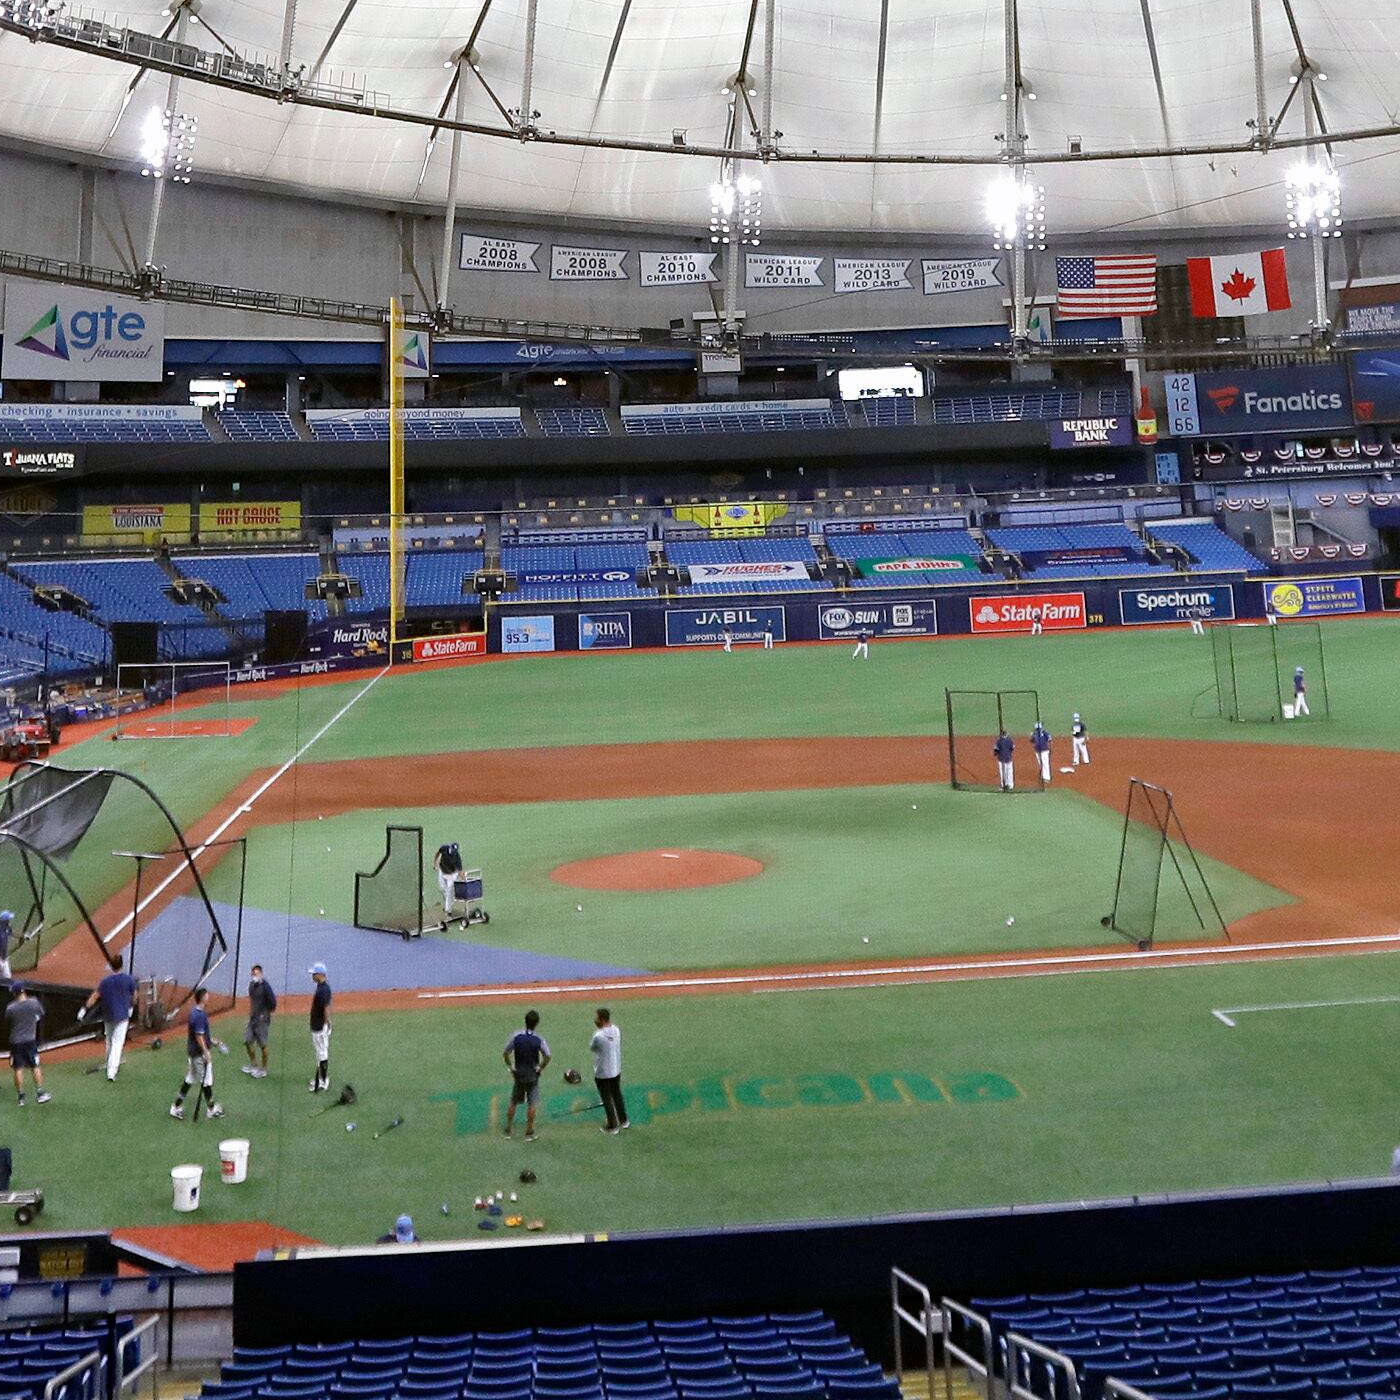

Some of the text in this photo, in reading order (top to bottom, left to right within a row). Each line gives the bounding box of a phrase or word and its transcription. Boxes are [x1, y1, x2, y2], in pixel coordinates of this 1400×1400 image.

[482, 239, 517, 249] AL EAST
[478, 247, 519, 261] 2008
[557, 250, 591, 258] AMERICAN
[466, 258, 528, 270] CHAMPIONS
[568, 257, 608, 269] 2008
[657, 261, 697, 274] 2010
[926, 260, 992, 271] AMERICAN LEAGUE
[556, 268, 618, 278] CHAMPIONS
[646, 273, 707, 282] CHAMPIONS
[764, 265, 801, 277] 2011
[854, 269, 892, 280] 2013
[941, 268, 975, 281] 2019
[754, 276, 779, 284] WILD
[842, 279, 900, 288] WILD CARD
[933, 278, 987, 289] WILD CARD
[70, 304, 146, 350] gte
[83, 344, 154, 363] financial
[1171, 377, 1190, 391] 42
[663, 401, 788, 414] auto credit cards home
[1175, 397, 1189, 412] 12
[1243, 389, 1343, 415] Fanatics
[1, 405, 178, 419] checking insurance savings
[432, 408, 466, 419] money
[1062, 418, 1119, 432] REPUBLIC
[1175, 417, 1194, 432] 66
[1074, 429, 1109, 442] BANK
[1271, 464, 1325, 475] Petersburg
[1326, 462, 1372, 471] Welcomes
[217, 507, 240, 526] HOT
[721, 563, 782, 575] HUGHES
[877, 561, 912, 572] PAPA
[525, 572, 600, 582] MOFFITT
[1137, 591, 1210, 612] Spectrum
[1306, 591, 1357, 602] CLEARWATER
[695, 611, 758, 625] JABIL
[854, 610, 880, 624] SUN
[332, 627, 388, 643] Hard Rock
[594, 621, 625, 636] RIPA
[505, 633, 529, 644] 95.3
[686, 633, 716, 643] SUPPORTS
[300, 660, 328, 673] Hard Rock
[236, 669, 266, 682] Hard Rock
